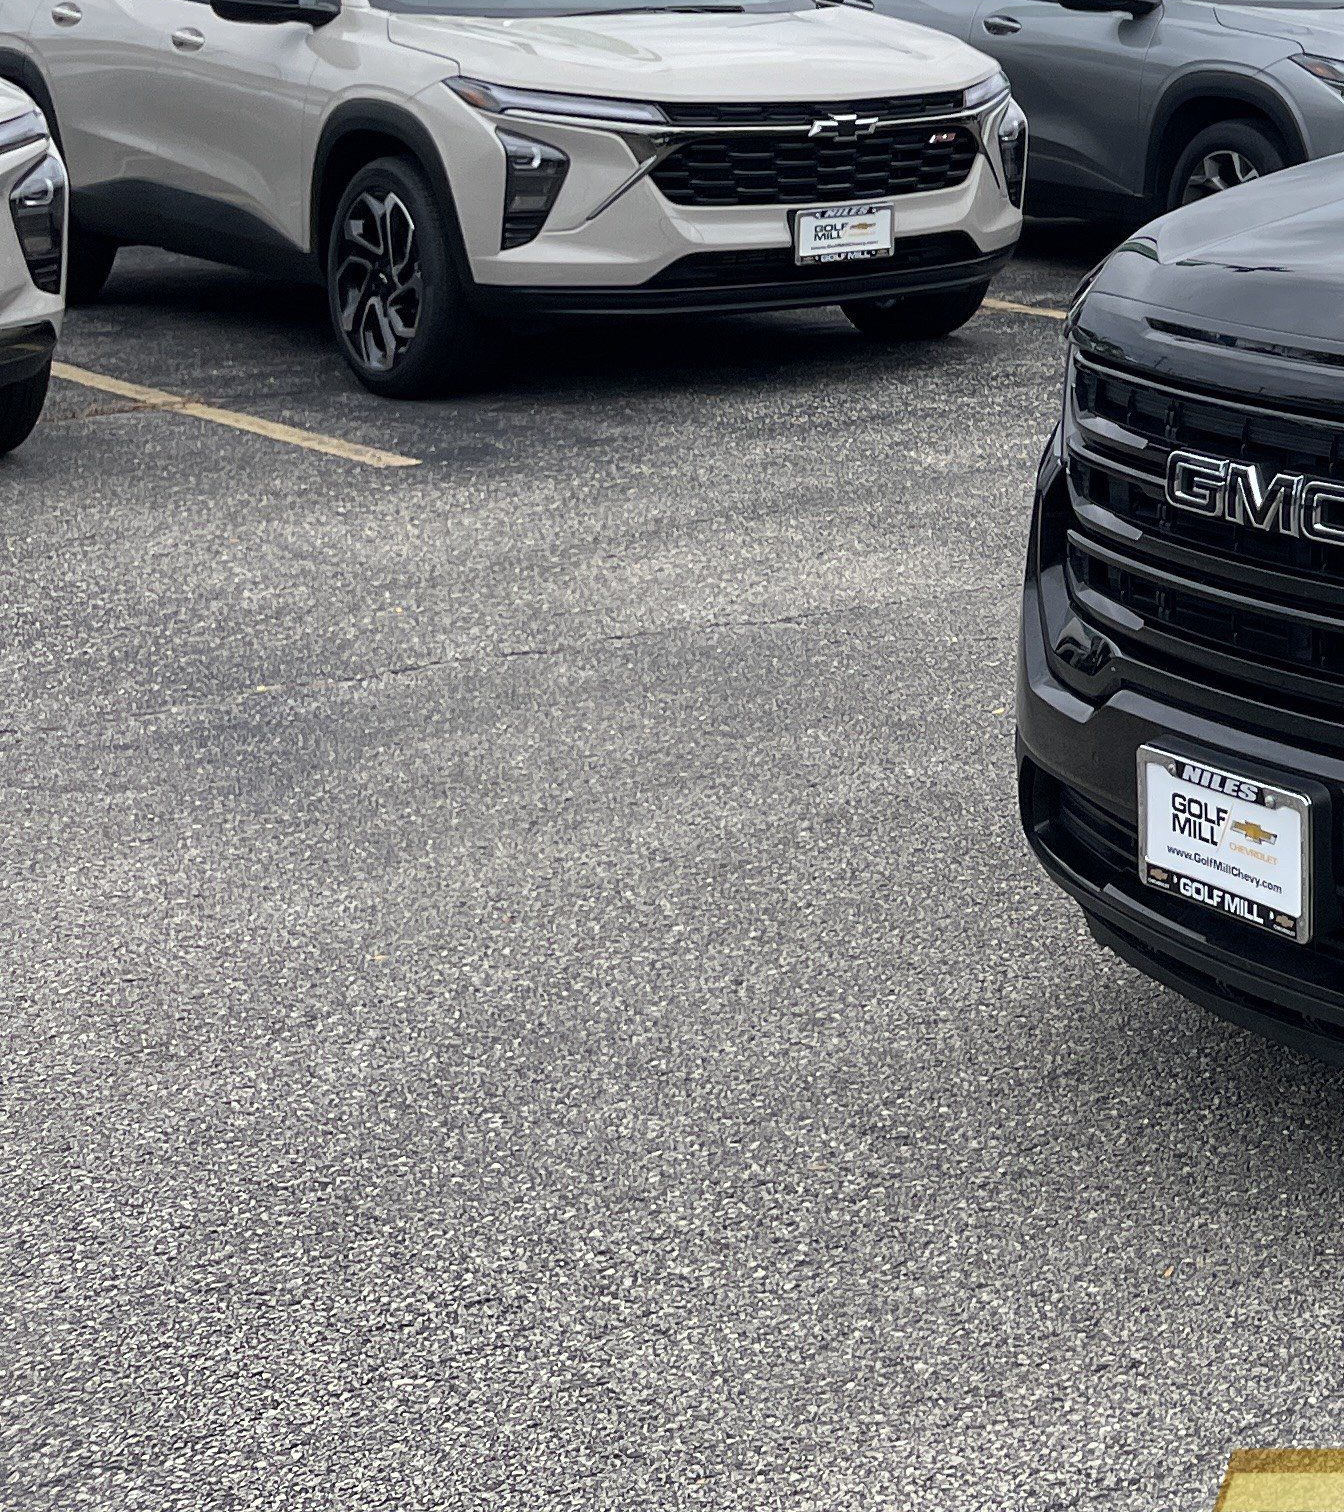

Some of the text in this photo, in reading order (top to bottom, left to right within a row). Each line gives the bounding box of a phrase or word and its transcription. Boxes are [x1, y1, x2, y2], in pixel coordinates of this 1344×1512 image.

[813, 231, 842, 242] MILL
[814, 222, 849, 233] GOLF
[1182, 764, 1259, 802] NILES
[1171, 792, 1229, 827] GOLF
[1172, 813, 1219, 847] MILL
[1167, 844, 1283, 894] www.GolfMillChevy.com
[1229, 842, 1279, 866] CHEVROLET
[1180, 878, 1224, 906] GOLF
[1224, 893, 1264, 924] MILL
